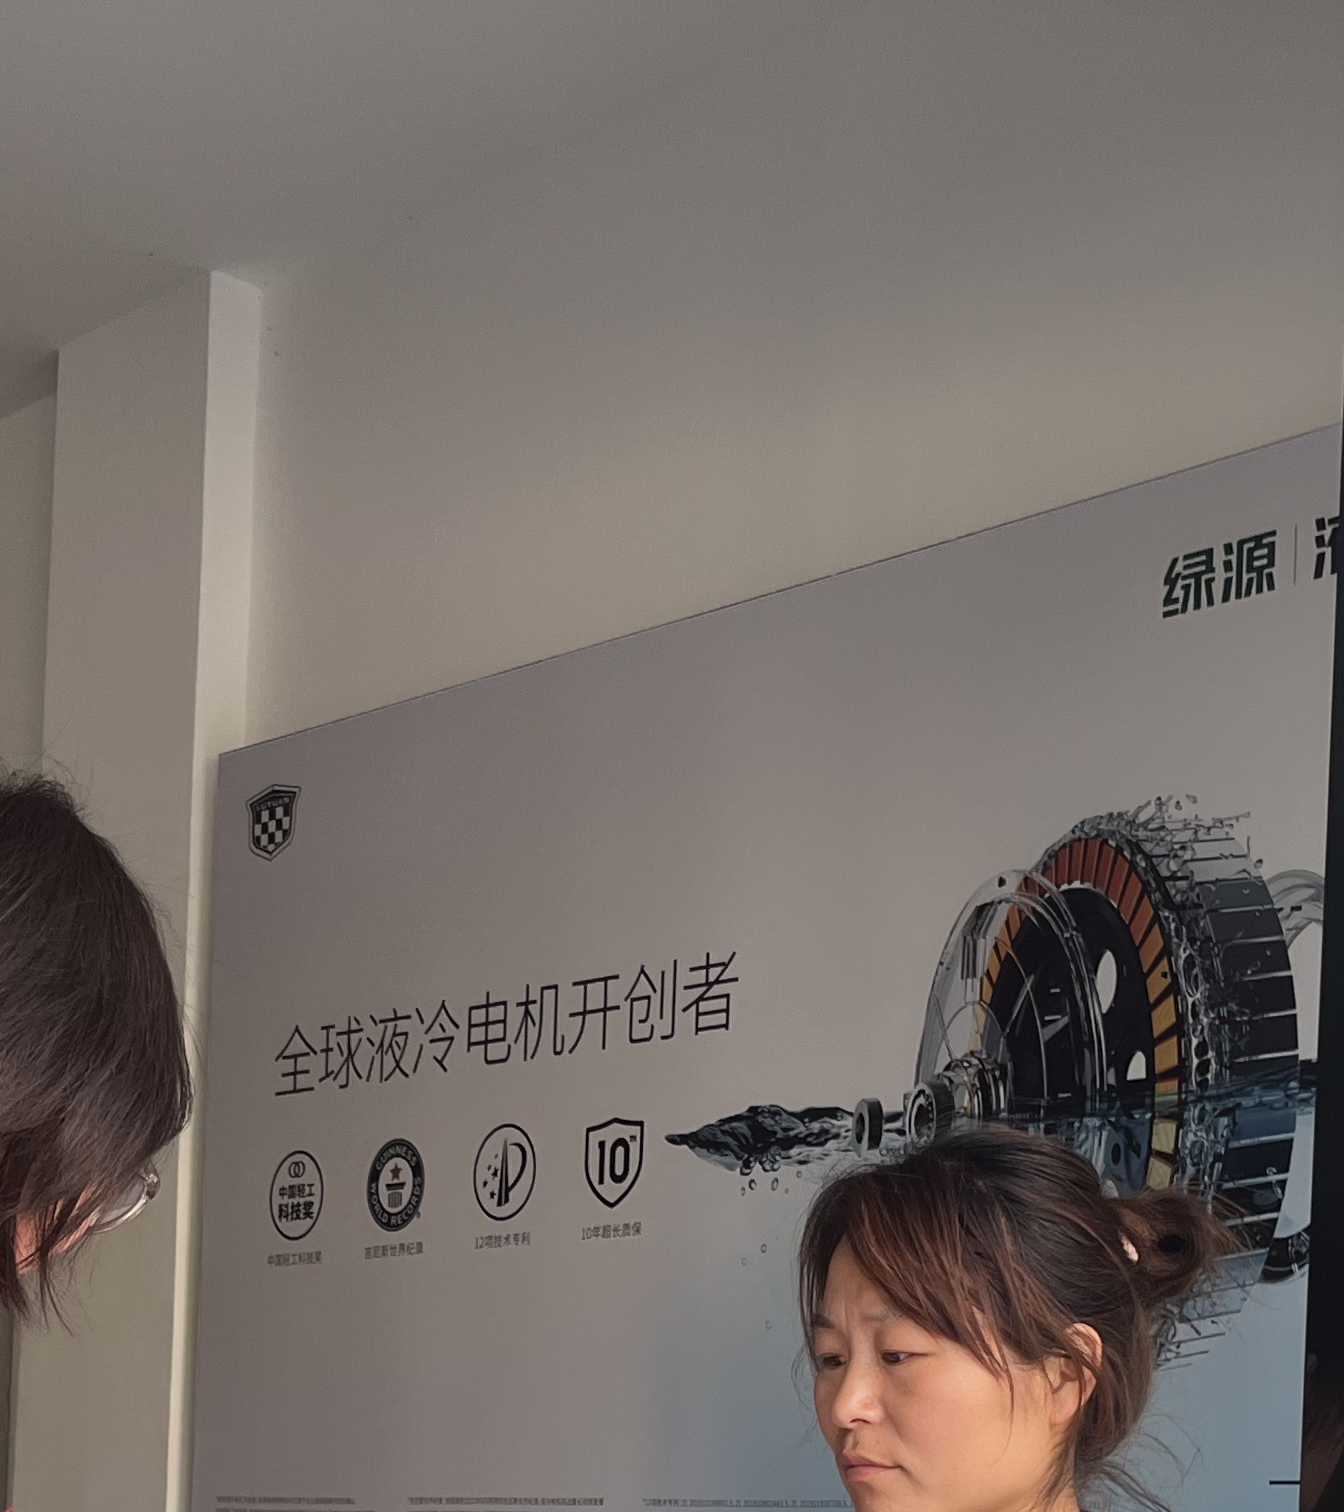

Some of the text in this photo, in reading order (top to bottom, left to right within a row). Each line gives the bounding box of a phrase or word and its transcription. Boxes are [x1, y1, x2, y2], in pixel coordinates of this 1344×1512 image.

[1162, 529, 1277, 619] 绿源
[274, 951, 739, 1097] 全球液冷电机开创者
[375, 1144, 418, 1172] GUINNESS
[598, 1137, 630, 1186] 10
[277, 1200, 315, 1223] 科技奖
[279, 1183, 316, 1200] 中国轻工
[370, 1176, 423, 1226] WORLD RECORDS
